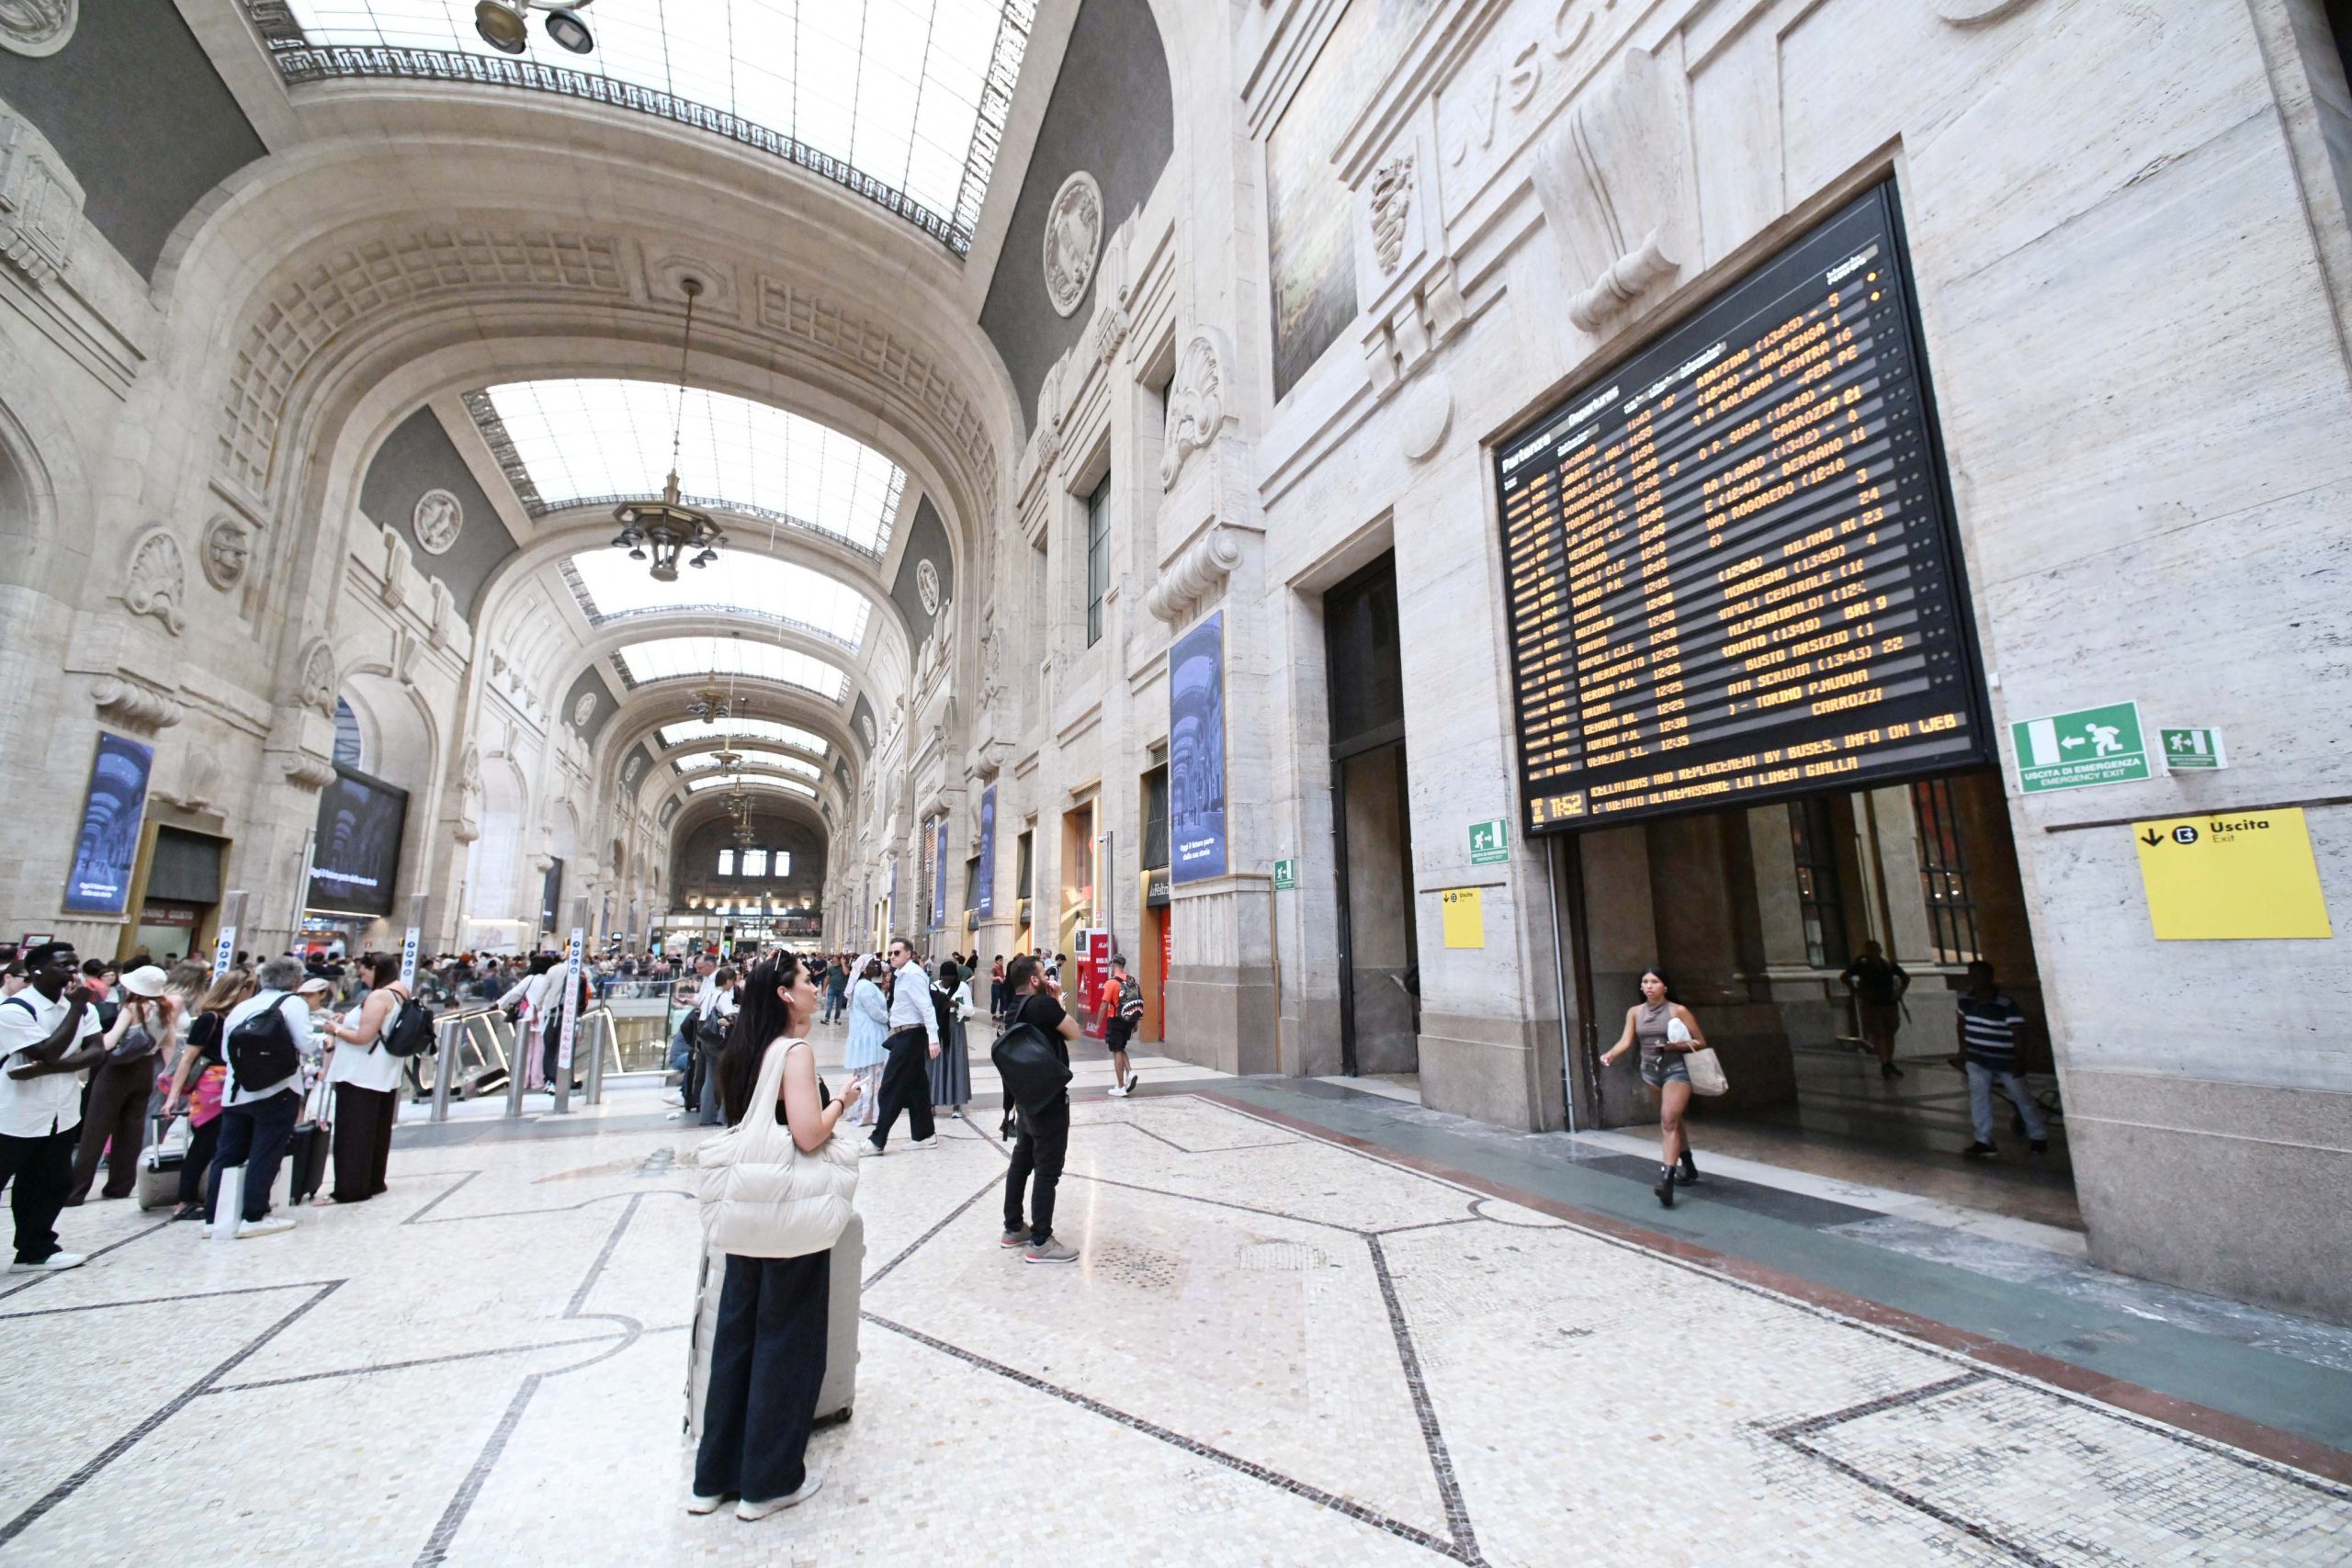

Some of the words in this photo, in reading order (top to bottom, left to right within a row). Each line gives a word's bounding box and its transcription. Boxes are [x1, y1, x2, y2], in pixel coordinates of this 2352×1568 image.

[1559, 443, 1597, 472] LOCARNO
[1695, 348, 1749, 389] RIAZZINO
[1755, 316, 1804, 352] (13:25)
[1827, 292, 1839, 307] 5
[1561, 462, 1590, 488] ARATE
[1604, 442, 1625, 461] MAL
[1758, 321, 1826, 369] MALPENSA
[1831, 312, 1840, 327] 1
[1562, 477, 1592, 502] NAPOLI
[1595, 463, 1616, 483] C.LE
[1719, 373, 1773, 412] BOLOGNA
[1779, 340, 1829, 377] CENTRA
[1834, 326, 1852, 345] 16
[1563, 477, 1623, 517] DOMODOSSOLA
[1837, 344, 1857, 366] PE
[1567, 386, 1619, 426] Departures
[1565, 508, 1595, 531] TORINO
[1711, 440, 1724, 453] P.
[1728, 419, 1760, 444] SUSA
[1566, 533, 1578, 547] LA
[1580, 515, 1613, 539] SPEZIA
[1842, 385, 1861, 404] 21
[1569, 551, 1608, 577] BERGAMO
[1717, 476, 1761, 505] (12:41)
[1781, 437, 1843, 476] BERGAMO
[1849, 425, 1866, 444] 11
[1567, 536, 1604, 561] VENEZIA
[1607, 527, 1624, 541] S.L.
[1702, 478, 1719, 495] RA
[1570, 570, 1601, 592] NAPOLI
[1604, 558, 1625, 576] C.LE
[1730, 480, 1794, 519] ROGOREDO
[1571, 586, 1602, 607] TORINO
[1855, 468, 1867, 483] 3
[1573, 604, 1601, 624] PARMA
[1858, 486, 1879, 504] 24
[1574, 615, 1614, 639] BOZZOLO
[1782, 527, 1833, 556] MILANO
[1861, 506, 1883, 525] 23
[1577, 635, 1607, 655] TIRANO
[1724, 566, 1787, 599] MORBEGNO
[1792, 544, 1846, 573] (13:59)
[1866, 532, 1876, 545] 4
[1577, 651, 1610, 671] NAPOLI
[1764, 570, 1831, 604] CENTRALE
[1580, 683, 1614, 702] VERONA
[1771, 616, 1820, 641] (13:19)
[1874, 594, 1887, 610] 9
[1581, 702, 1611, 718] ARONA
[1655, 680, 1683, 697] 12:25
[1745, 649, 1785, 671] BUSTO
[1791, 629, 1849, 657] ARSIZIO
[1583, 716, 1618, 735] GENOVA
[1621, 712, 1638, 725] BR.
[1757, 662, 1810, 687] SCRIVIA
[1816, 645, 1871, 671] (13:43)
[1882, 636, 1904, 653] 22
[1591, 656, 1645, 682] AEROPORTO
[1586, 734, 1618, 750] TORINO
[1756, 686, 1802, 707] TORINO
[1807, 669, 1868, 694] P.NUOVA
[1586, 750, 1625, 767] VENEZIA
[1629, 745, 1648, 758] S.L.
[1660, 734, 1690, 750] 12:35
[1652, 771, 1674, 784] AND
[1678, 755, 1756, 780] REPLACEMENT
[1763, 749, 1781, 763] BY
[1787, 739, 1837, 759] BUSES.
[1844, 728, 1880, 748] INFO
[1887, 723, 1910, 739] ON
[1917, 713, 1956, 733] WEB
[1549, 794, 1582, 818] 11:52
[1604, 795, 1645, 811] VIETATO
[1648, 780, 1729, 804] OLTREPASSARE
[1736, 775, 1754, 789] LA
[1758, 767, 1799, 784] LINEA
[1804, 756, 1858, 776] GIALLA
[2024, 769, 2061, 781] USCITA
[2062, 767, 2075, 776] DI
[2074, 757, 2141, 774] EMERGENZA
[2041, 773, 2100, 786] EMERGENCY
[2102, 768, 2125, 778] EXIT
[2211, 819, 2269, 833] Uscita
[2212, 834, 2234, 842] Exit
